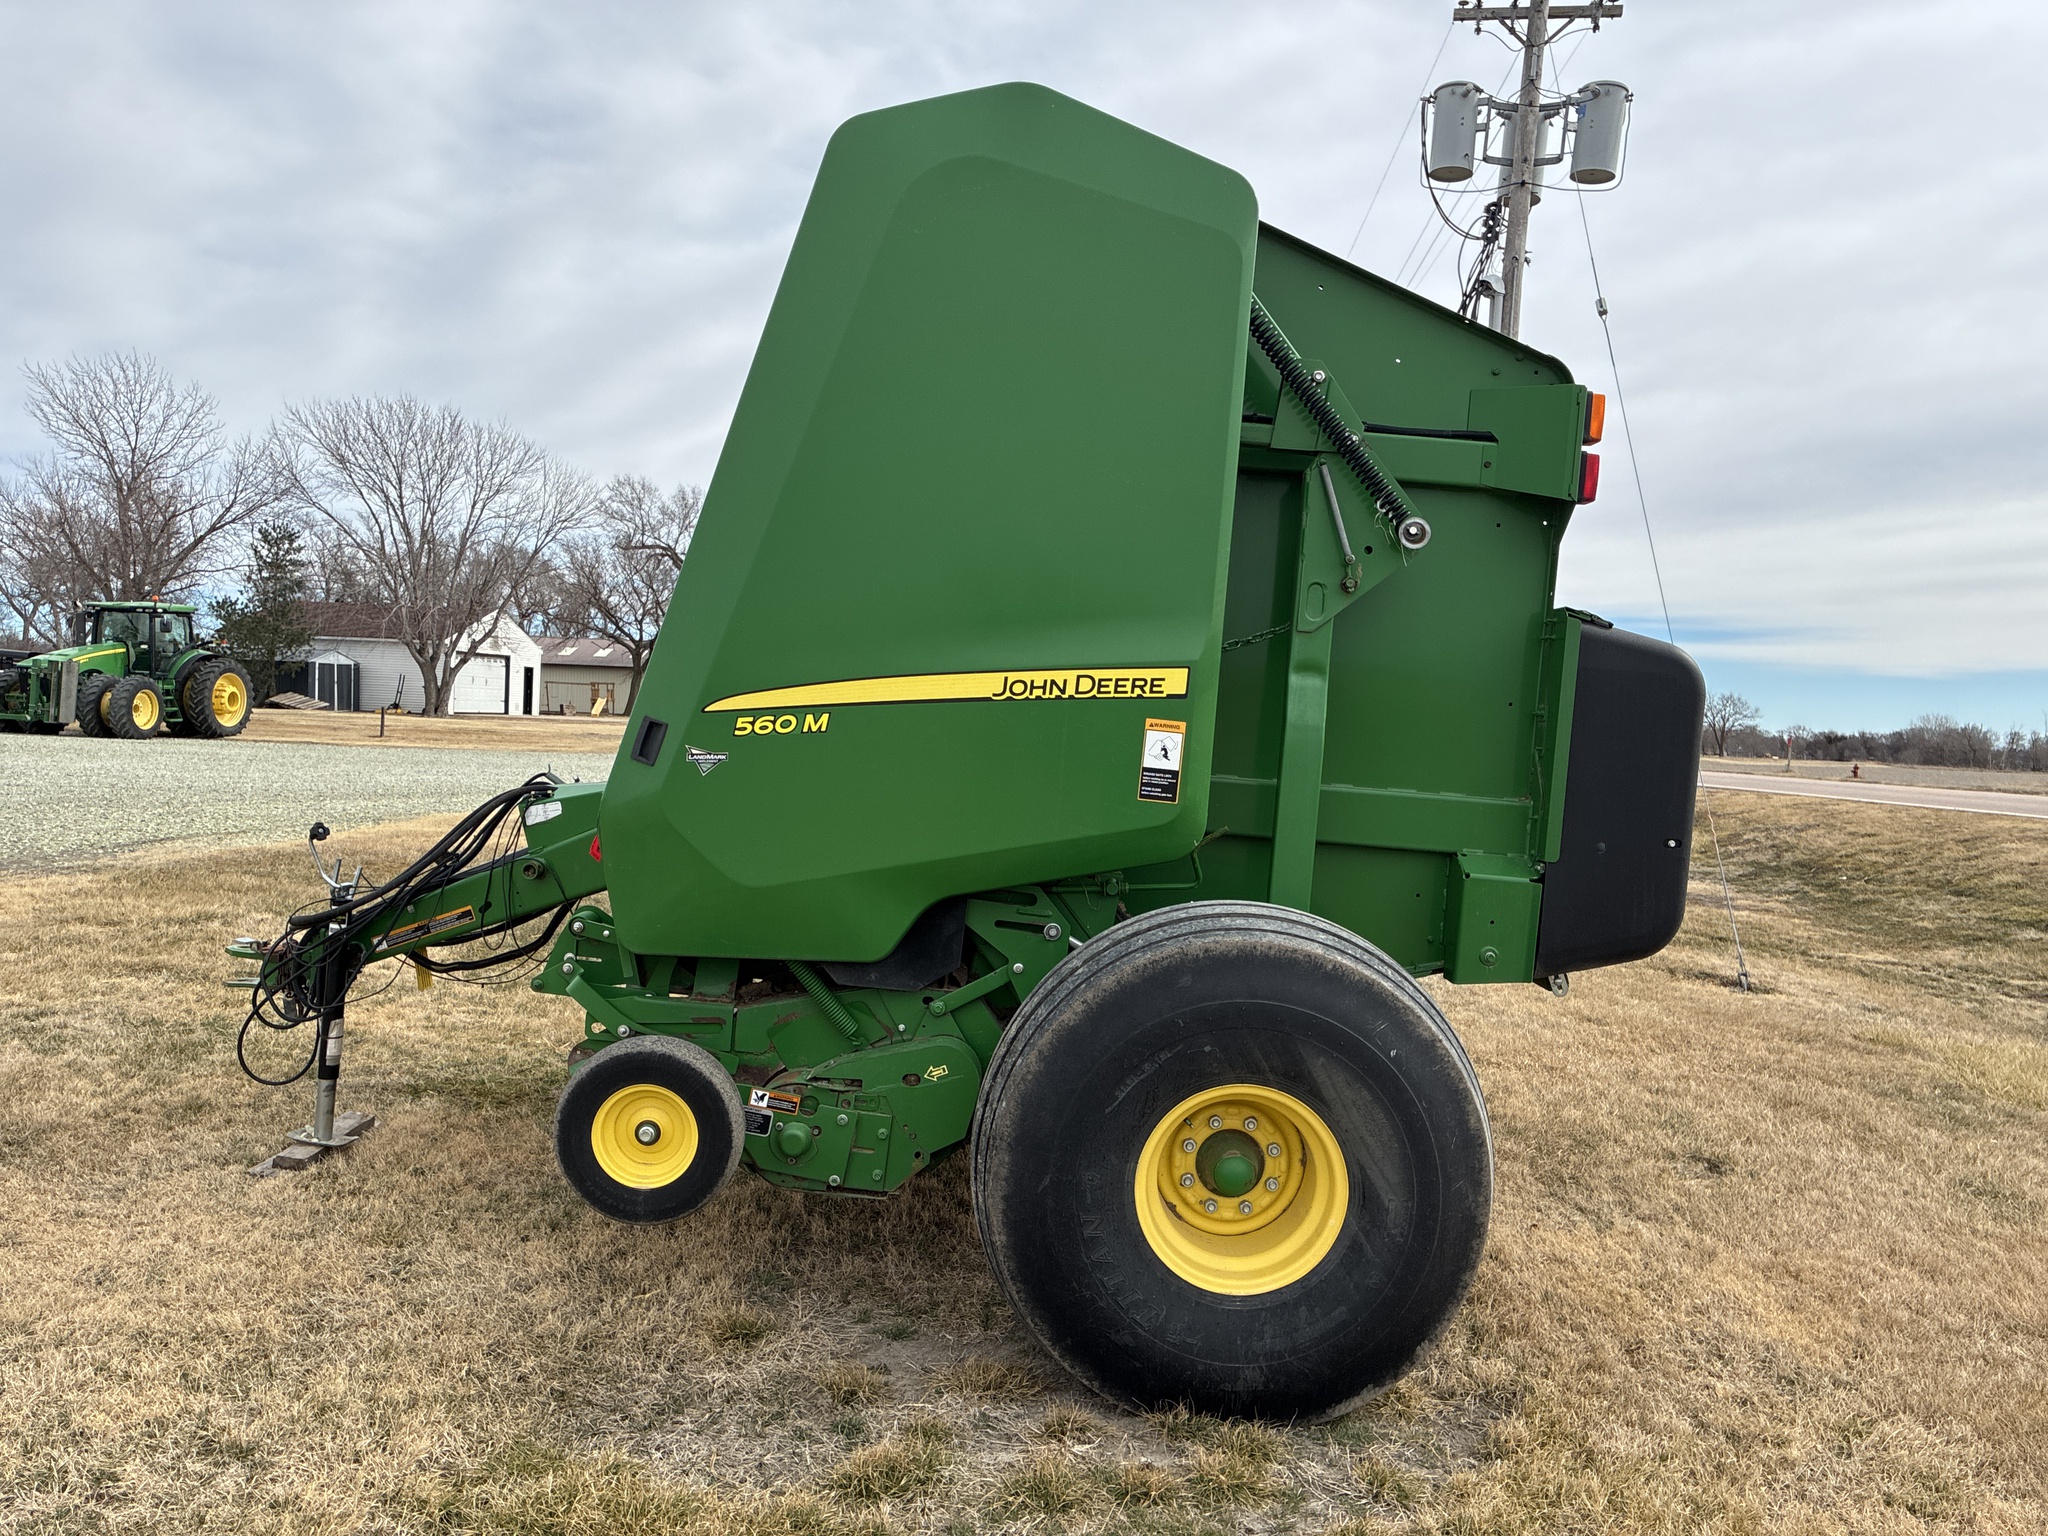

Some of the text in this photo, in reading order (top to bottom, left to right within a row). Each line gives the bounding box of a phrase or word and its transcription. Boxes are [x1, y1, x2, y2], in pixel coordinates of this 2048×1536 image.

[992, 674, 1165, 697] JOHN DEERE
[733, 712, 831, 736] 560 M
[1154, 722, 1180, 730] WARNING
[1080, 1213, 1162, 1330] TITAN
